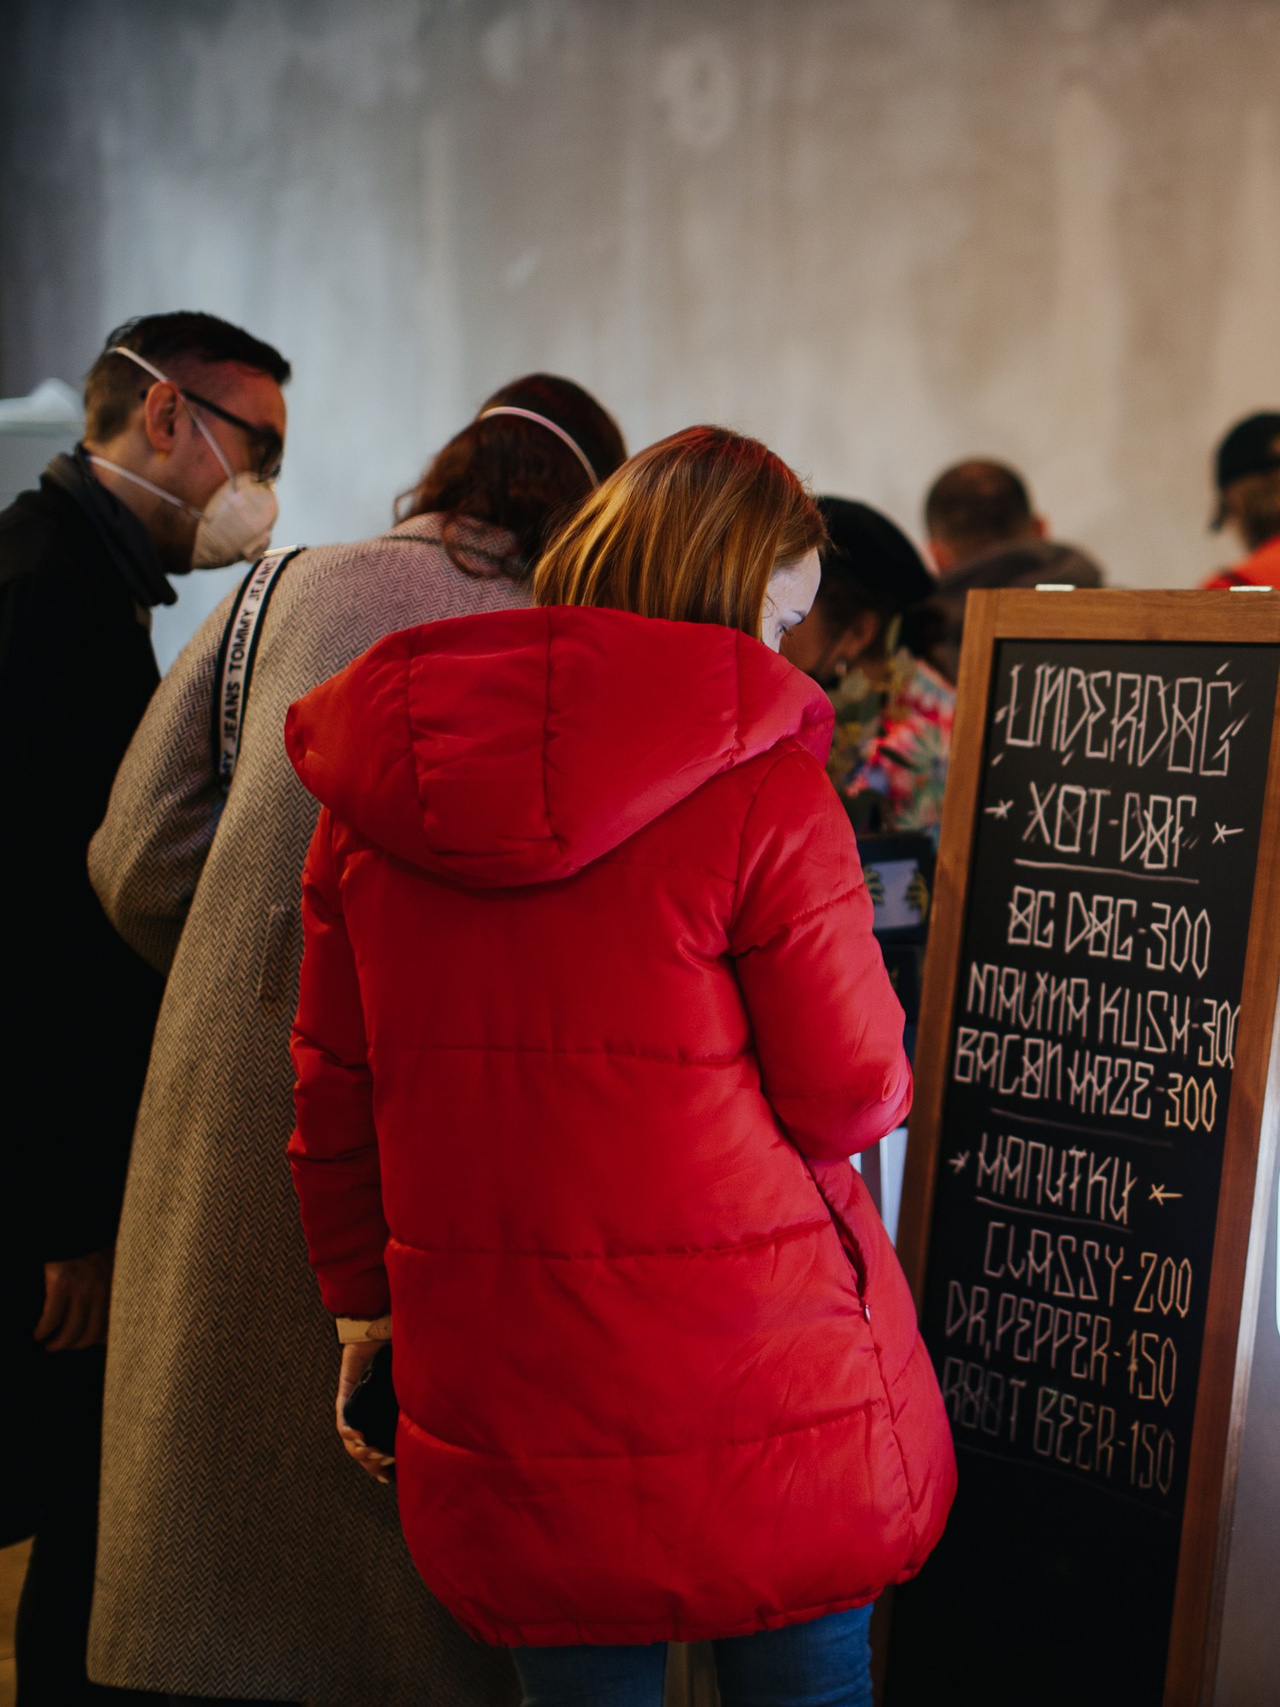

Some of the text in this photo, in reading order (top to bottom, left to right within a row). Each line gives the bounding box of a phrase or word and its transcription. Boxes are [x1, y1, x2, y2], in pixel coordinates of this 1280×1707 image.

[228, 609, 254, 673] TOMMY
[224, 682, 240, 741] JEANS
[1004, 664, 1236, 776] UNDERDOG
[953, 1026, 1063, 1100] BACON
